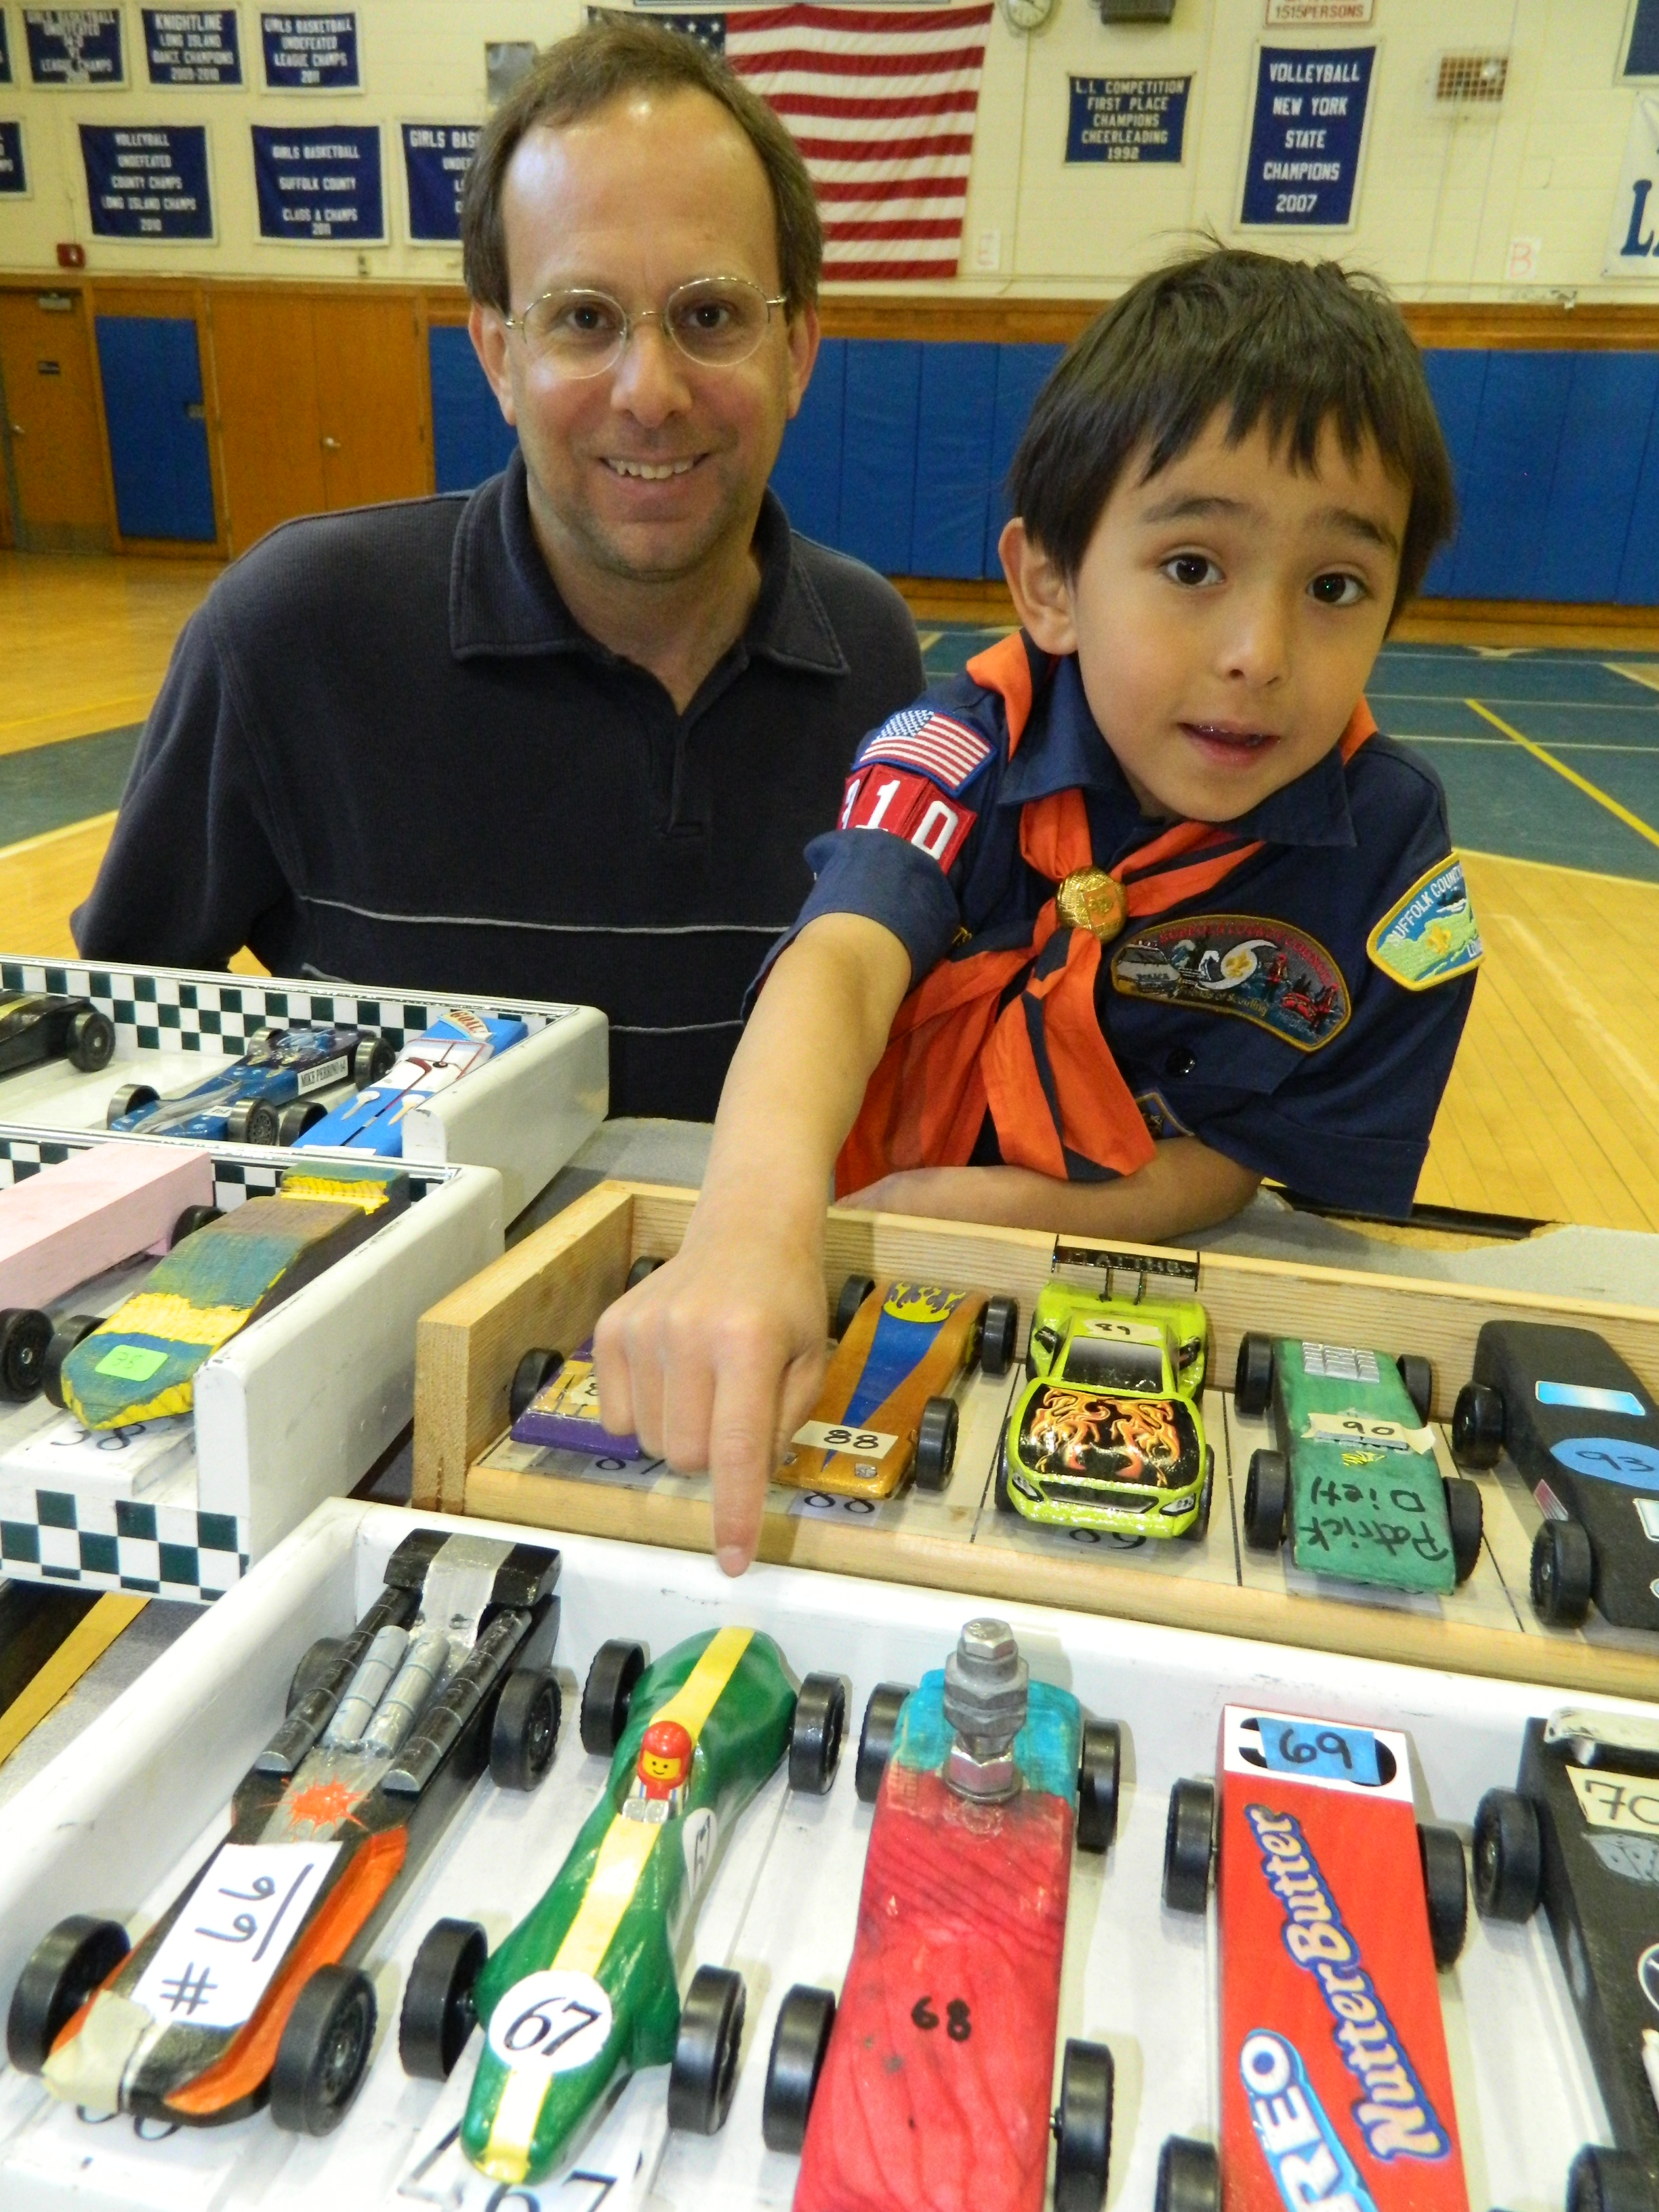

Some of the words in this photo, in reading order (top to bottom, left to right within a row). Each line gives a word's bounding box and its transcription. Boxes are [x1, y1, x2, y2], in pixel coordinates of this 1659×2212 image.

[155, 14, 222, 31] KNIGHTLINE
[264, 18, 292, 33] GIRLS
[295, 18, 352, 33] BASKETBALL
[281, 36, 337, 50] UNDEFEATED
[274, 52, 308, 66] LEAGUE
[312, 52, 348, 66] CHAMPS
[1269, 62, 1359, 83] VOLLEYBALL
[1105, 79, 1185, 94] COMPETITION
[1087, 96, 1122, 110] FIRST
[1129, 96, 1170, 110] PLACE
[1273, 96, 1303, 116] NEW
[1311, 96, 1349, 116] YORK
[1093, 113, 1160, 127] CHAMPIONS
[115, 133, 169, 146] VOLLEYBALL
[409, 129, 445, 148] GIRLS
[1081, 129, 1168, 144] CHEERLEADING
[1285, 129, 1327, 148] STATE
[272, 145, 300, 159] GIRLS
[304, 144, 361, 159] BASKETBALL
[117, 154, 172, 168] UNDEFEATED
[1263, 161, 1340, 181] CHAMPIONS
[111, 176, 145, 189] COUNTY
[148, 176, 183, 190] CHAMPS
[279, 176, 320, 190] SUFFOLK
[323, 177, 356, 190] COUNTY
[163, 197, 197, 210] CHAMPS
[1275, 194, 1318, 212] 2007
[282, 207, 312, 221] CLASS
[314, 208, 322, 221] A
[324, 207, 358, 221] CHAMPS
[1389, 891, 1435, 947] SUFFOLK
[1343, 1420, 1395, 1441] 90
[823, 1429, 879, 1450] 88
[1575, 1450, 1655, 1473] 93
[1299, 1517, 1449, 1561] Patrick
[1279, 1728, 1352, 1769] 69
[504, 1996, 602, 2057] 67
[911, 1995, 972, 2043] 68
[1238, 2028, 1364, 2212] REO
